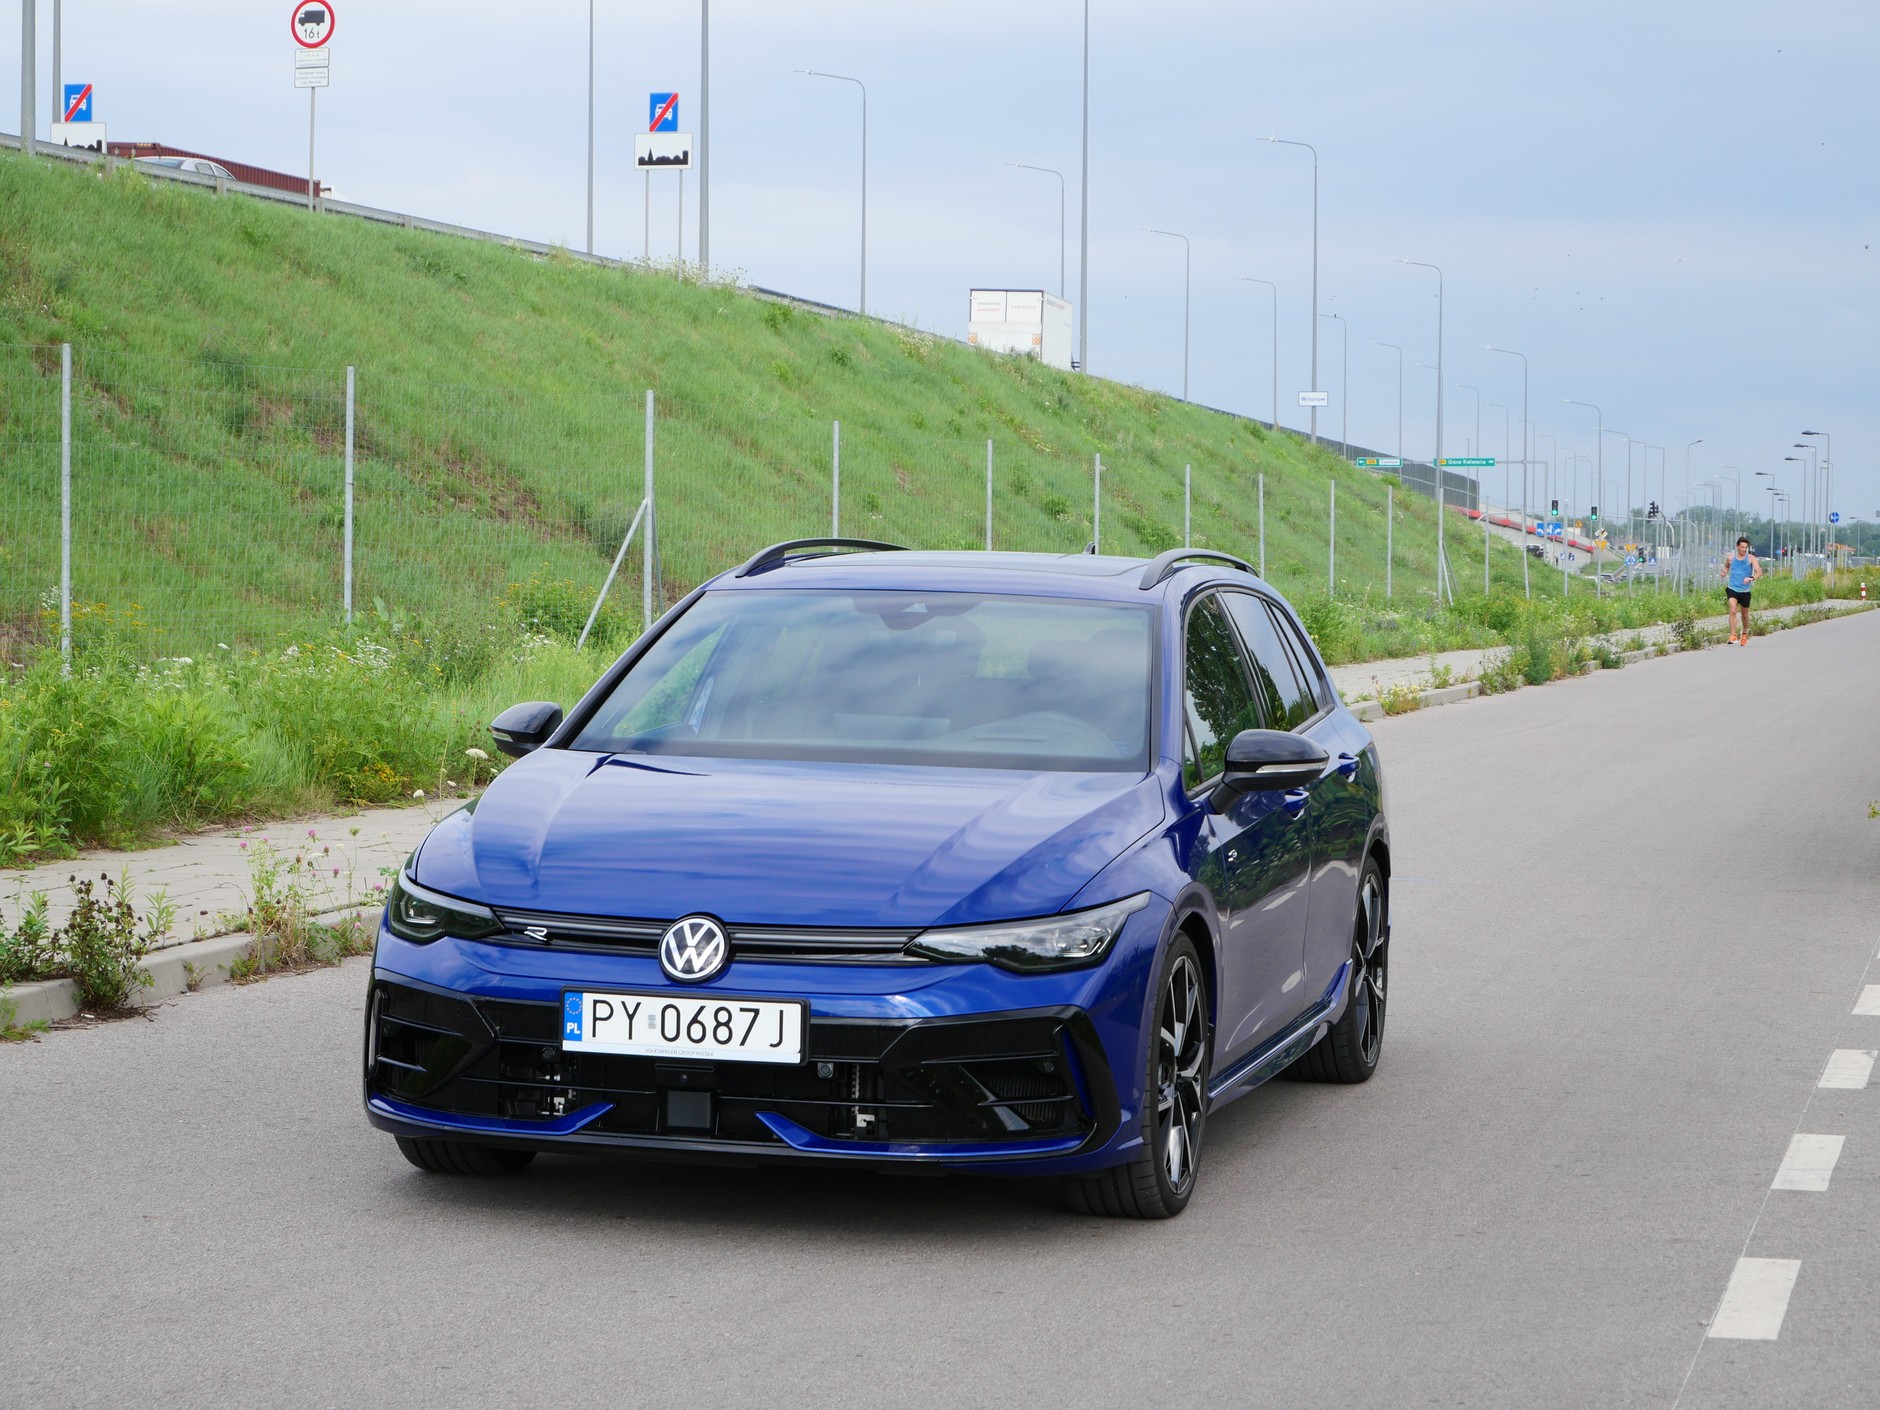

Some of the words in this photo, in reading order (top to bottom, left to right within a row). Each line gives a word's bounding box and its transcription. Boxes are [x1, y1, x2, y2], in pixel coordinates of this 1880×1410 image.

[304, 28, 315, 39] 16
[316, 30, 320, 39] t
[664, 921, 722, 975] VW
[566, 1022, 580, 1034] PL
[592, 999, 641, 1040] PY
[660, 1003, 784, 1048] 0687J
